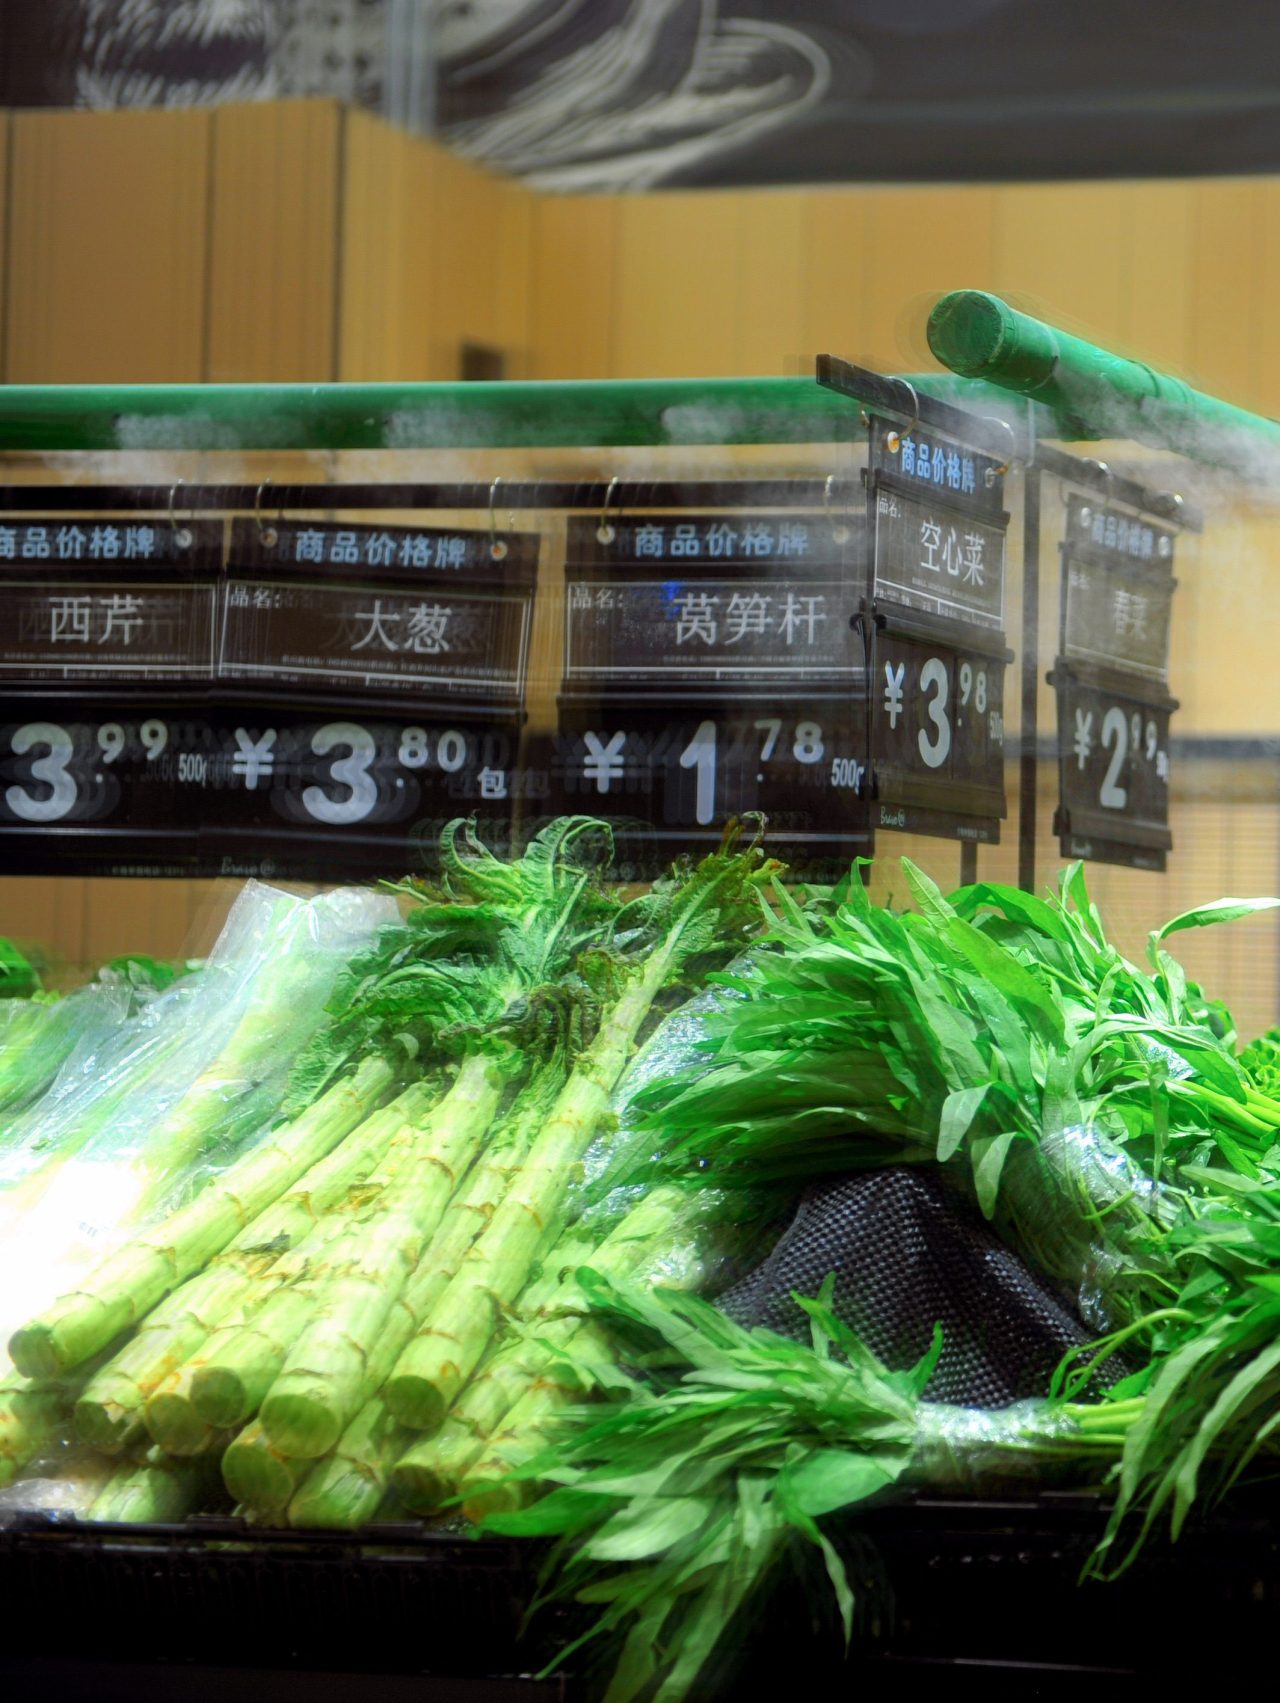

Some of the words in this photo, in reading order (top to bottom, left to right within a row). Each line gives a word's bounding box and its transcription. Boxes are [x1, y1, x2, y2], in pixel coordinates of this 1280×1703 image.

[902, 437, 976, 494] 商品价格牌
[296, 528, 466, 569] 商品价格牌
[635, 523, 809, 557] 商品价格牌
[920, 516, 985, 586] 空心菜
[49, 594, 143, 645] 西芹
[351, 599, 452, 654] 大葱
[674, 592, 827, 646] 莴笋杆
[477, 765, 508, 799] 包
